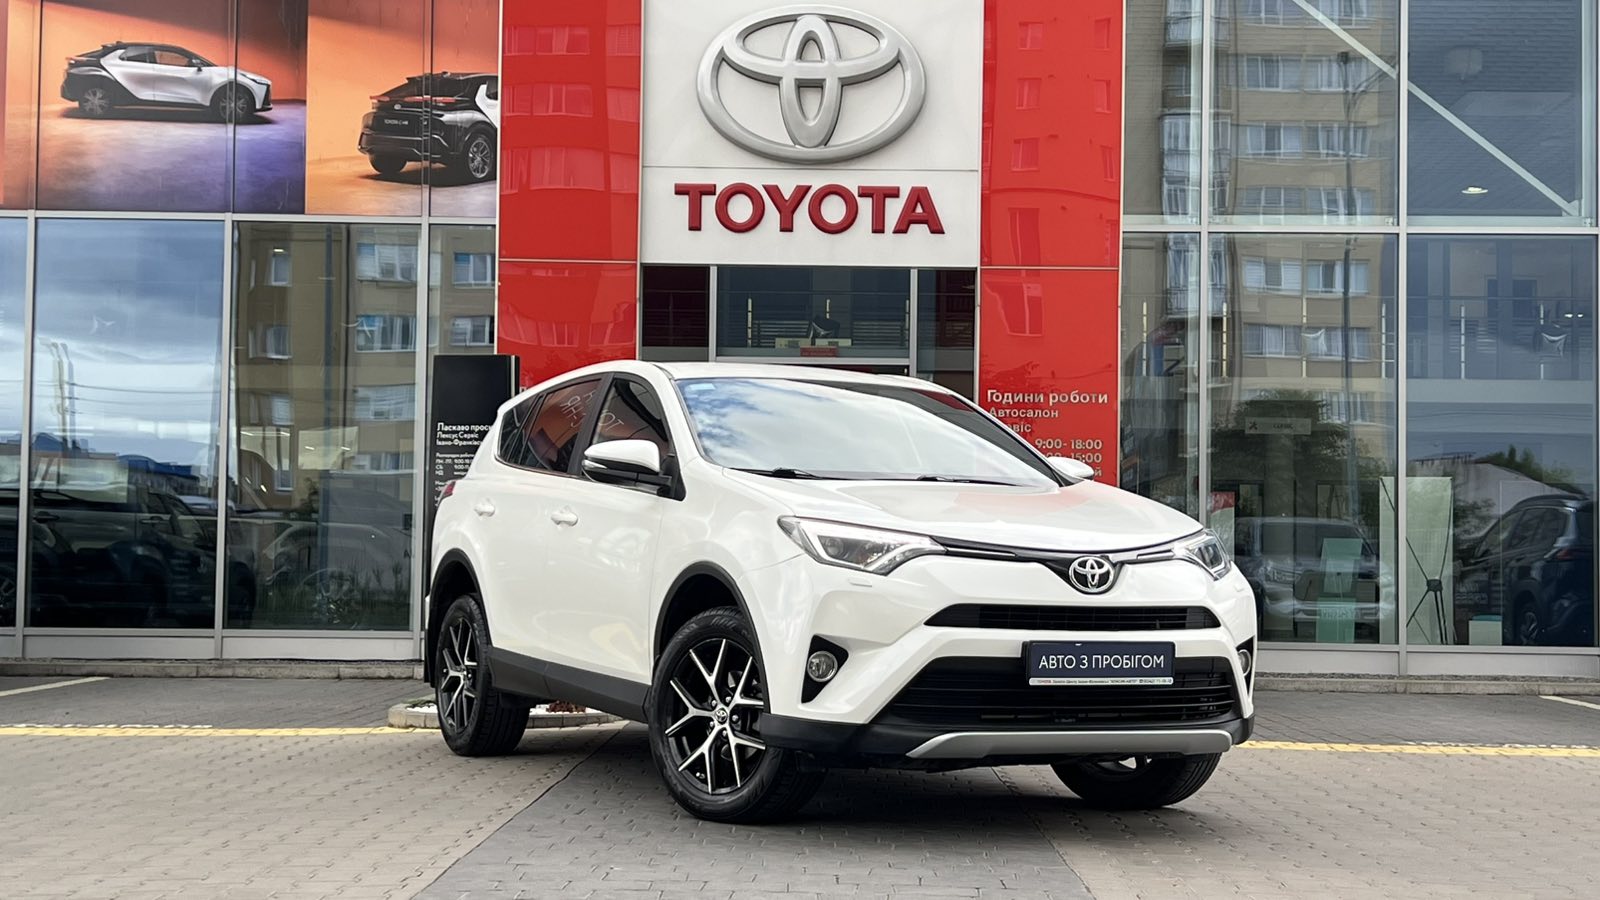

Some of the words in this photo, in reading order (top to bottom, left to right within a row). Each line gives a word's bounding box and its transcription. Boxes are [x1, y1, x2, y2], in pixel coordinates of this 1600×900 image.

[674, 182, 945, 235] TOYOTA
[987, 389, 1044, 405] Години
[1048, 390, 1108, 406] роботи
[989, 407, 1059, 418] Автосалон
[437, 422, 470, 431] Ласкаво
[1038, 655, 1076, 669] АВТО
[1092, 655, 1165, 669] ПРОБІГОМ
